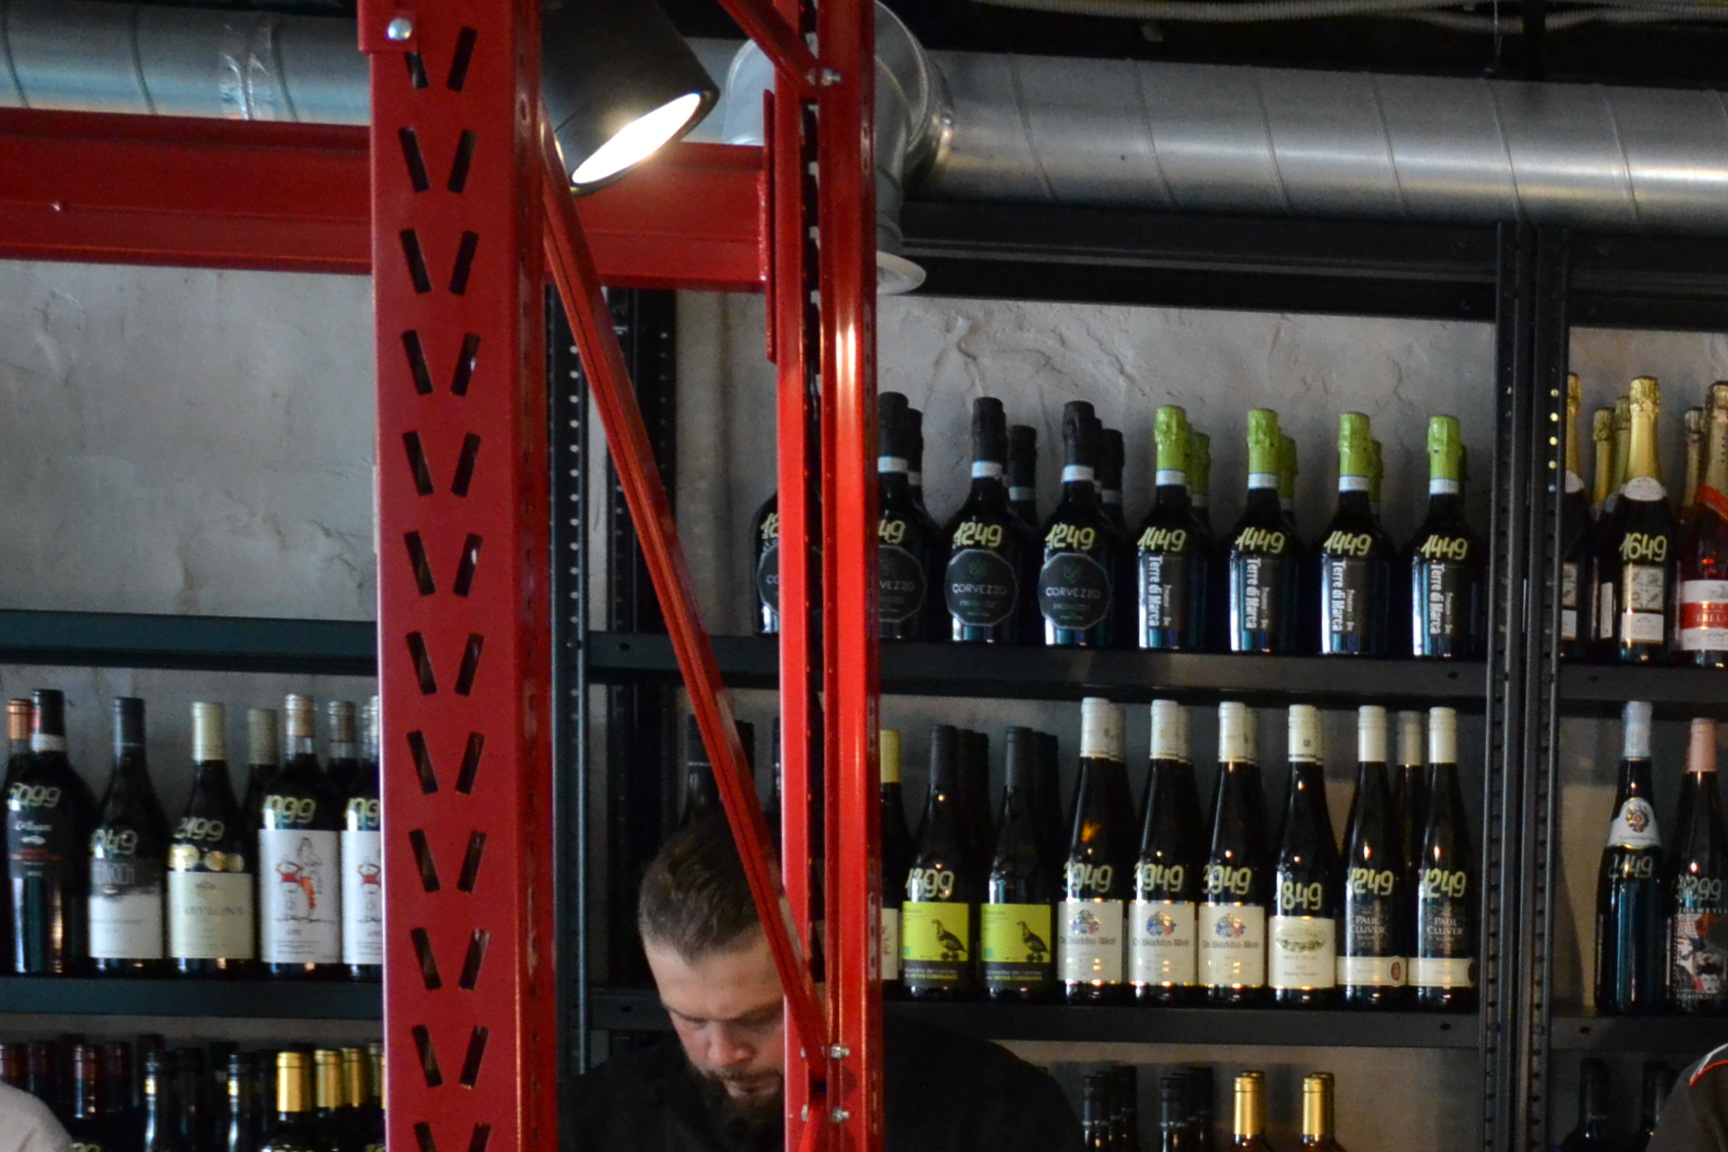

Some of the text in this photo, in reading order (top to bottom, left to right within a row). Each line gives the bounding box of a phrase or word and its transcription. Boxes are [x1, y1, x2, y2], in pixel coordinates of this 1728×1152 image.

[878, 519, 906, 544] 49
[952, 520, 1003, 549] 1249
[1044, 523, 1096, 552] 1249
[1136, 525, 1187, 553] 1449
[1235, 527, 1286, 555] 1449
[1323, 529, 1373, 556] 1449
[1420, 534, 1469, 561] 1449
[1618, 531, 1667, 563] 1649
[1148, 555, 1163, 584] Terre
[1246, 558, 1261, 585] Terre
[1332, 560, 1346, 587] Terre
[1430, 563, 1446, 591] Terre
[878, 581, 916, 593] VEZZO
[952, 582, 1008, 597] CORVEZZO
[1045, 585, 1101, 600] CORVEZZO
[1148, 594, 1162, 627] Marca
[1245, 596, 1260, 629] Marca
[1332, 600, 1346, 632] Marca
[1429, 602, 1444, 634] Marca
[1061, 860, 1113, 894] 3949
[1132, 860, 1184, 894] 3949
[1201, 862, 1253, 896] 3949
[1347, 867, 1395, 897] 1249
[1355, 915, 1380, 925] PAUL
[1433, 917, 1458, 927] PAUL
